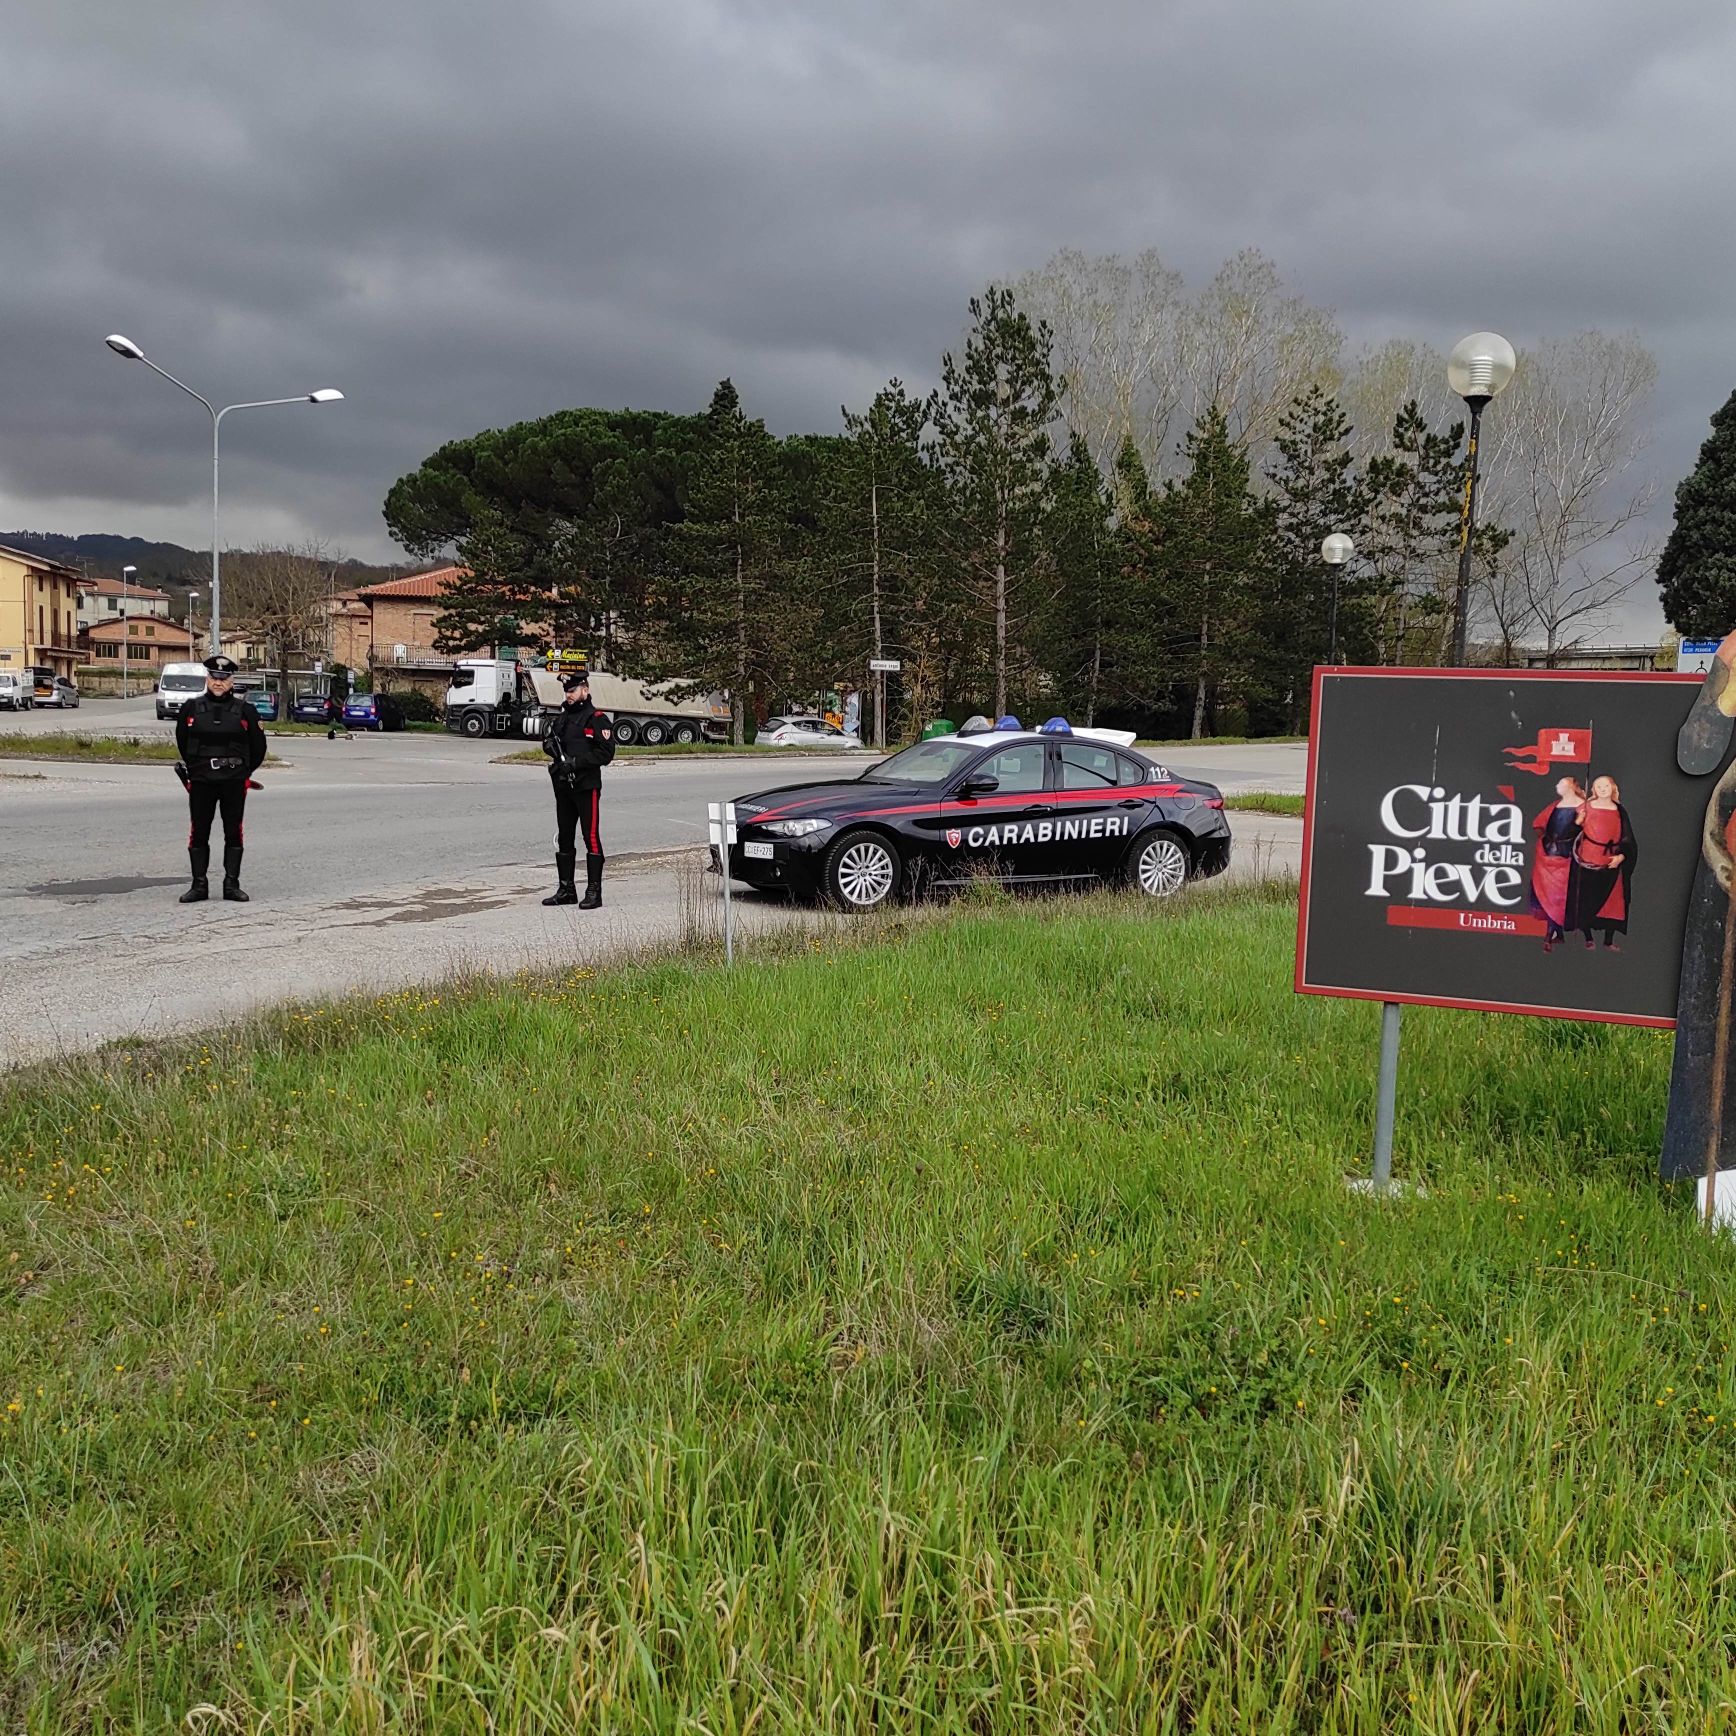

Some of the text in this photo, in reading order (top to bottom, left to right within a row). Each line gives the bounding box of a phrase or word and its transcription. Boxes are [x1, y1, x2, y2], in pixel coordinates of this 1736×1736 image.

[1149, 766, 1170, 779] 112
[1381, 784, 1526, 843] Città
[967, 816, 1129, 848] CARABINIERI
[1475, 844, 1524, 866] della
[1364, 844, 1522, 906] Pieve
[1459, 912, 1516, 930] Umbria
